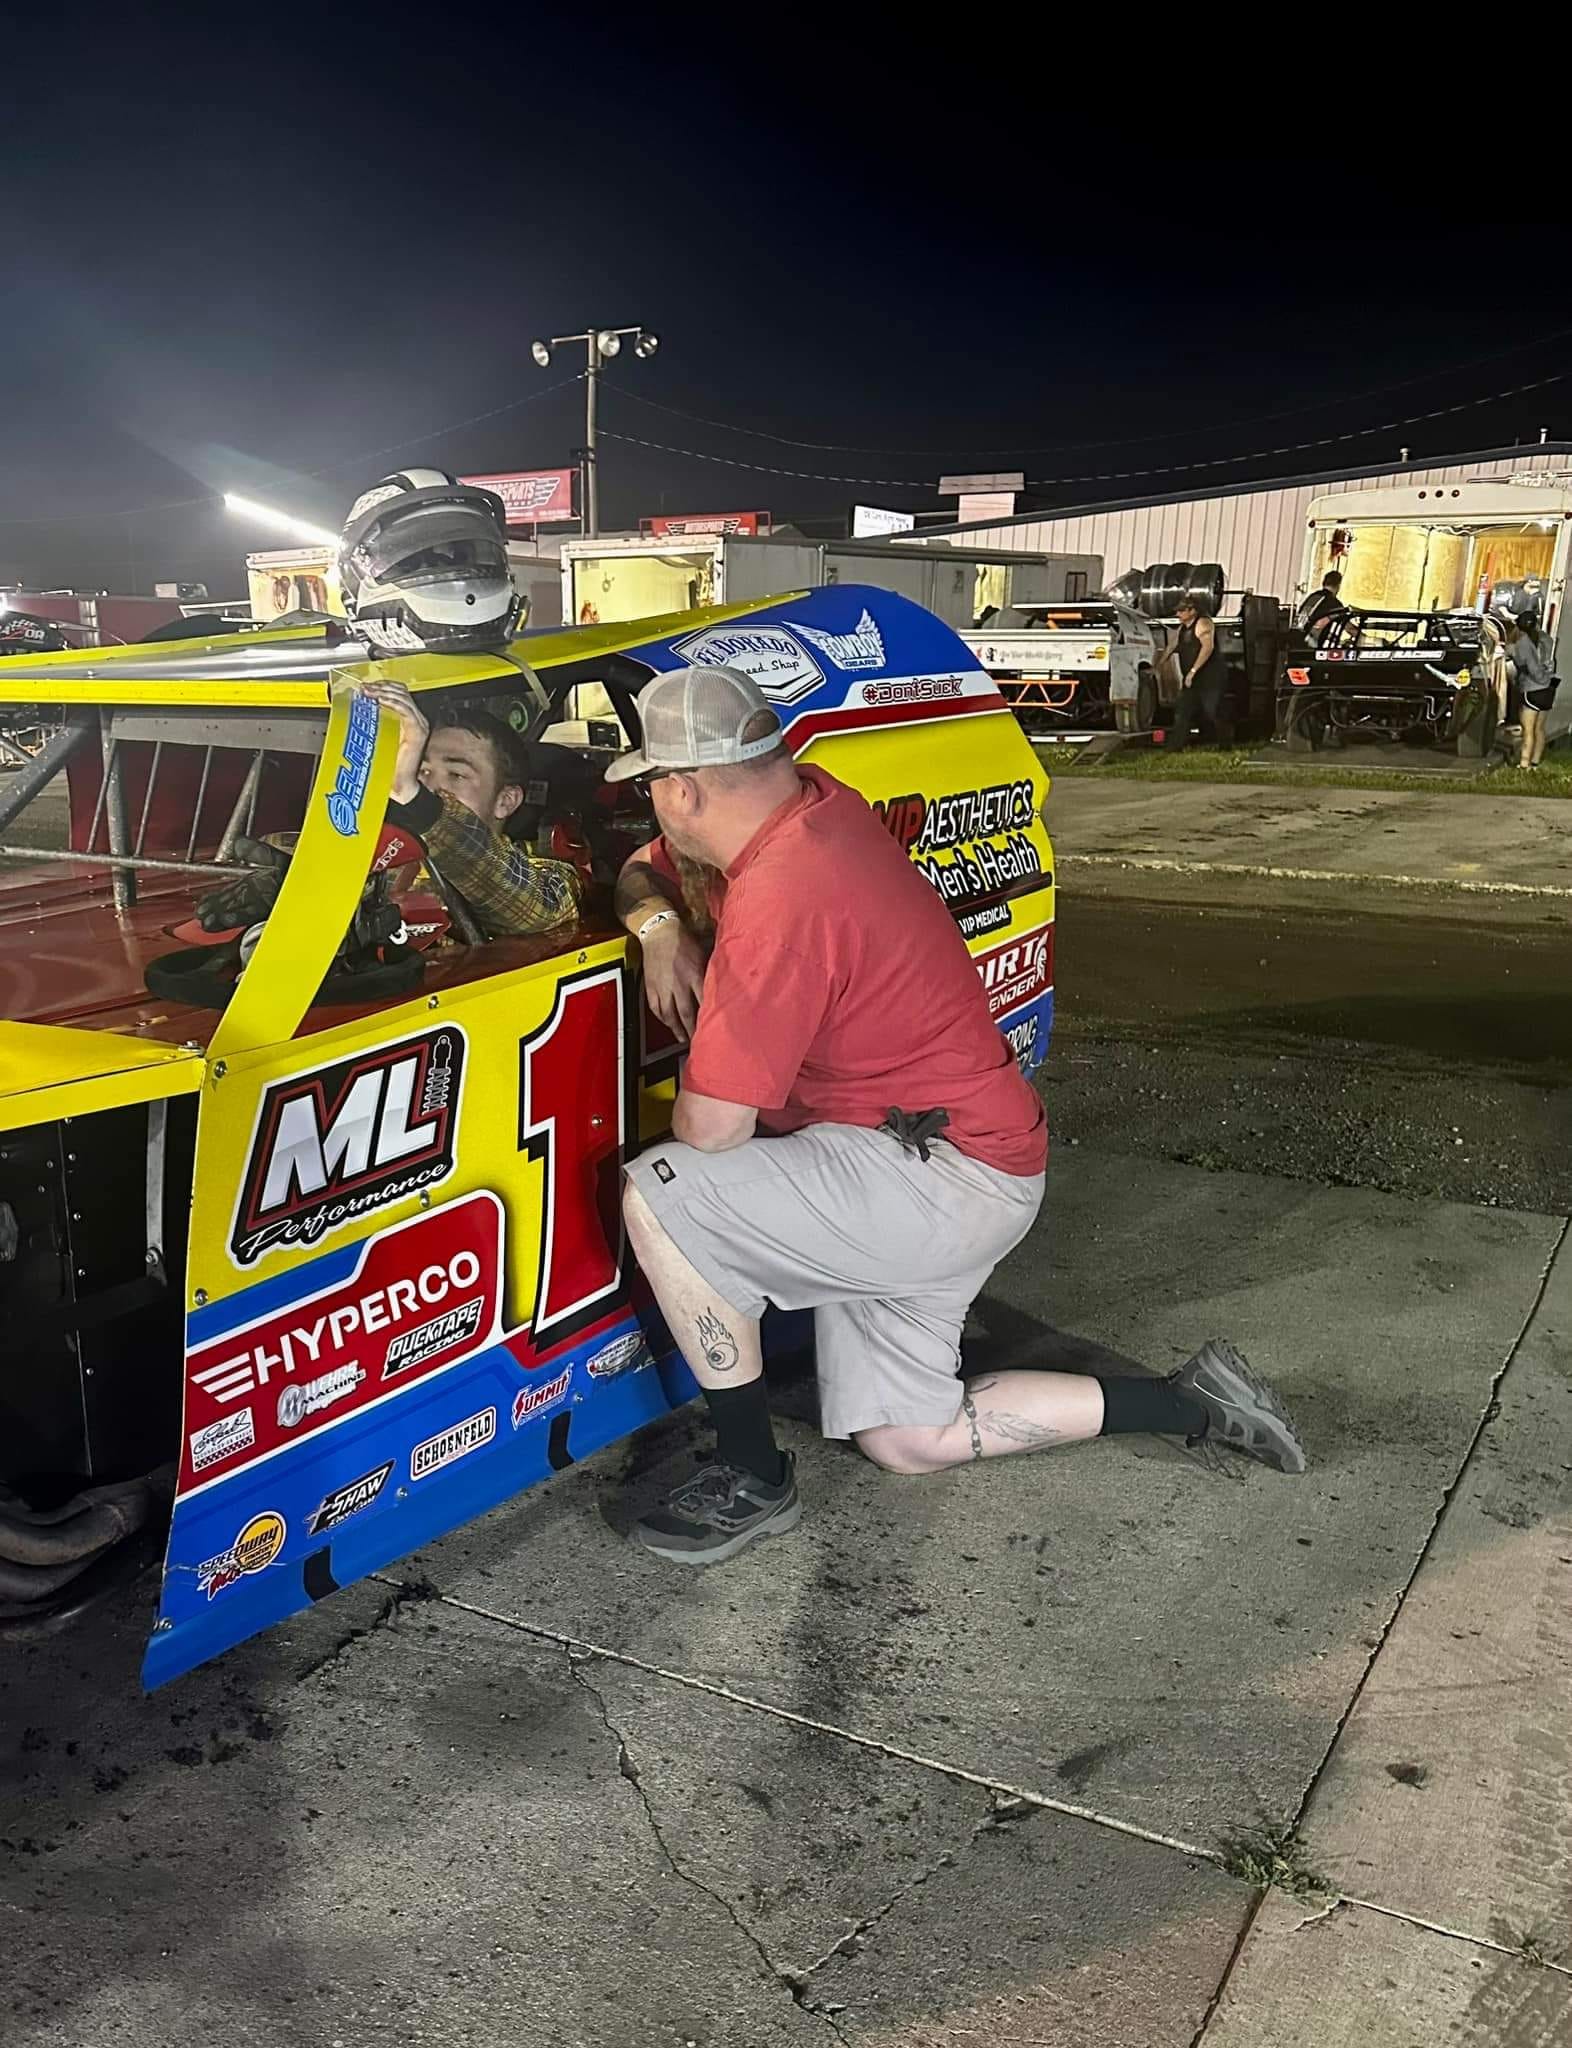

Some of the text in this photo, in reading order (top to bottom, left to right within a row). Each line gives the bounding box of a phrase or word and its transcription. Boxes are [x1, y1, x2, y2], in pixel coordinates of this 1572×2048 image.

[695, 635, 799, 665] EL DORADO
[743, 663, 769, 674] eed
[820, 631, 881, 660] COWBOY
[844, 659, 879, 668] GEARS
[920, 783, 1034, 848] AESTHETICS
[917, 840, 1040, 899] Men's Health
[959, 907, 1009, 934] VIP MEDICAL
[976, 936, 1039, 988] IRT
[989, 974, 1037, 1013] ENDER
[260, 1056, 437, 1212] ML
[521, 965, 625, 1339] 1
[239, 1161, 448, 1259] Performance
[254, 1250, 480, 1385] HYPERCO
[398, 1328, 467, 1369] RACING
[301, 1372, 365, 1408] MACHINE
[514, 1373, 569, 1424] SUMMIT
[416, 1414, 491, 1471] SCHOENFELD
[326, 1467, 389, 1520] SHAW
[200, 1524, 280, 1573] SPEEDWAY
